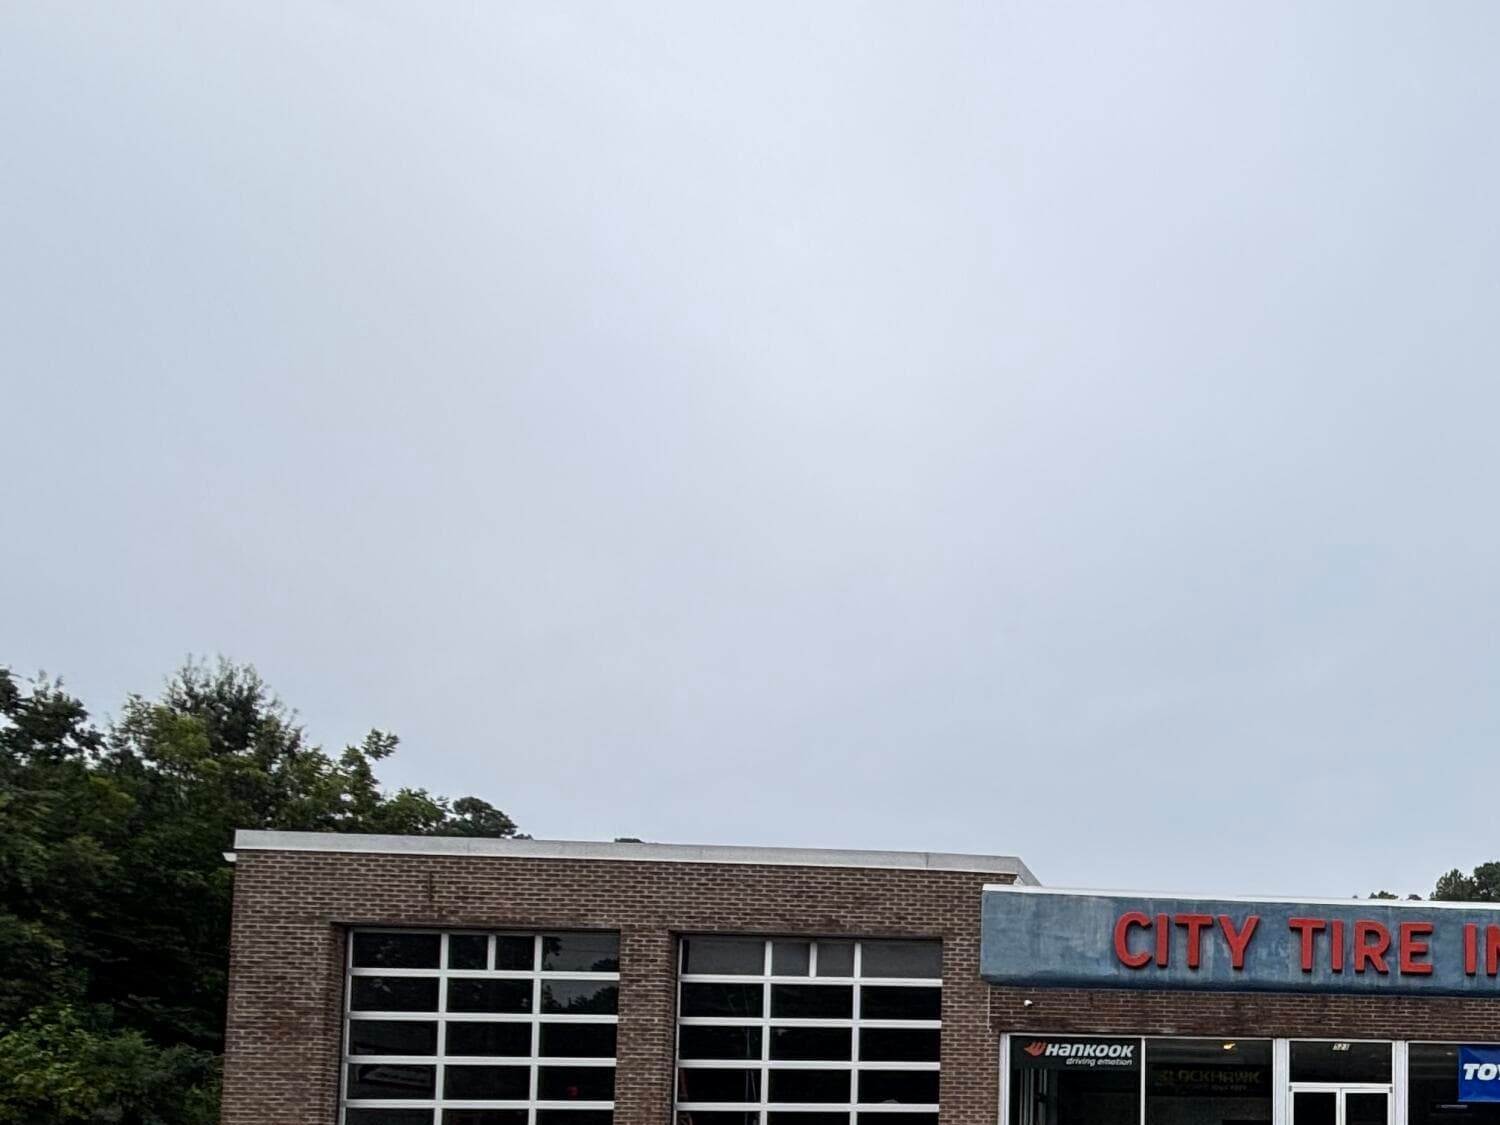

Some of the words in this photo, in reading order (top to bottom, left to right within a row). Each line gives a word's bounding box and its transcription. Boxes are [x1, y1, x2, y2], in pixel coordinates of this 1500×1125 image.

[1114, 911, 1261, 969] CITY
[1288, 917, 1433, 975] TIRE
[1066, 1058, 1096, 1067] driving
